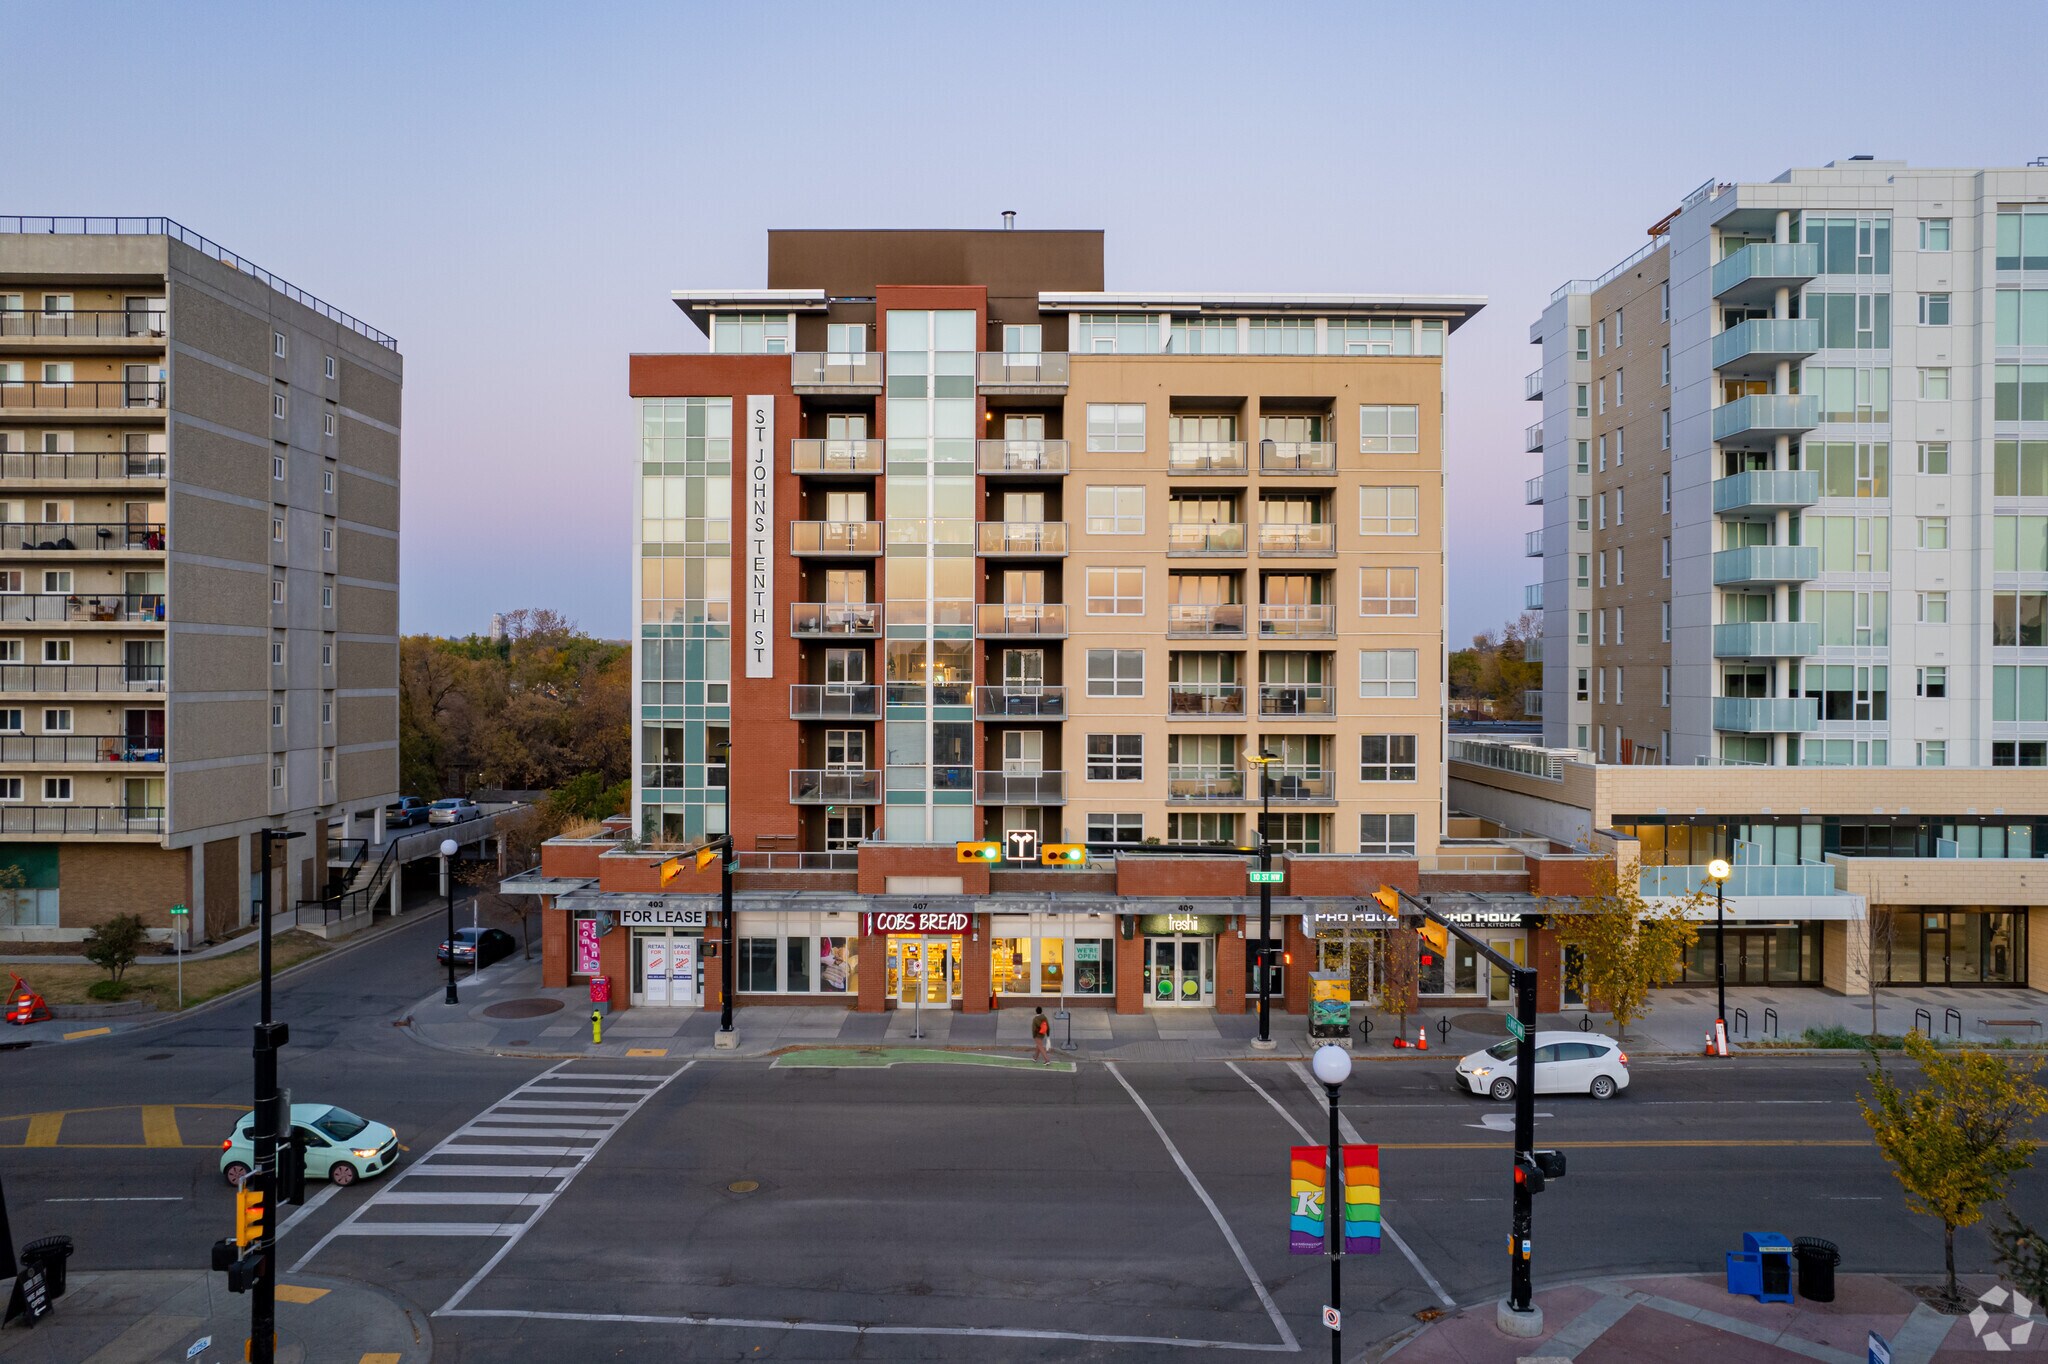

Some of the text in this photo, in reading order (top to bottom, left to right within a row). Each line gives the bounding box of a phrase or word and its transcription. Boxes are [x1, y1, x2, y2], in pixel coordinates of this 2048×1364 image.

[754, 409, 766, 663] ST JOHNS TENTH ST
[1271, 873, 1280, 881] NW
[623, 910, 702, 923] FOR LEASE
[1178, 904, 1194, 912] 409
[877, 913, 916, 930] COBS
[919, 913, 968, 930] BREAD
[1168, 913, 1198, 931] freshii
[1476, 913, 1522, 922] HOUZ
[582, 921, 590, 970] Coming
[1294, 1191, 1322, 1216] K
